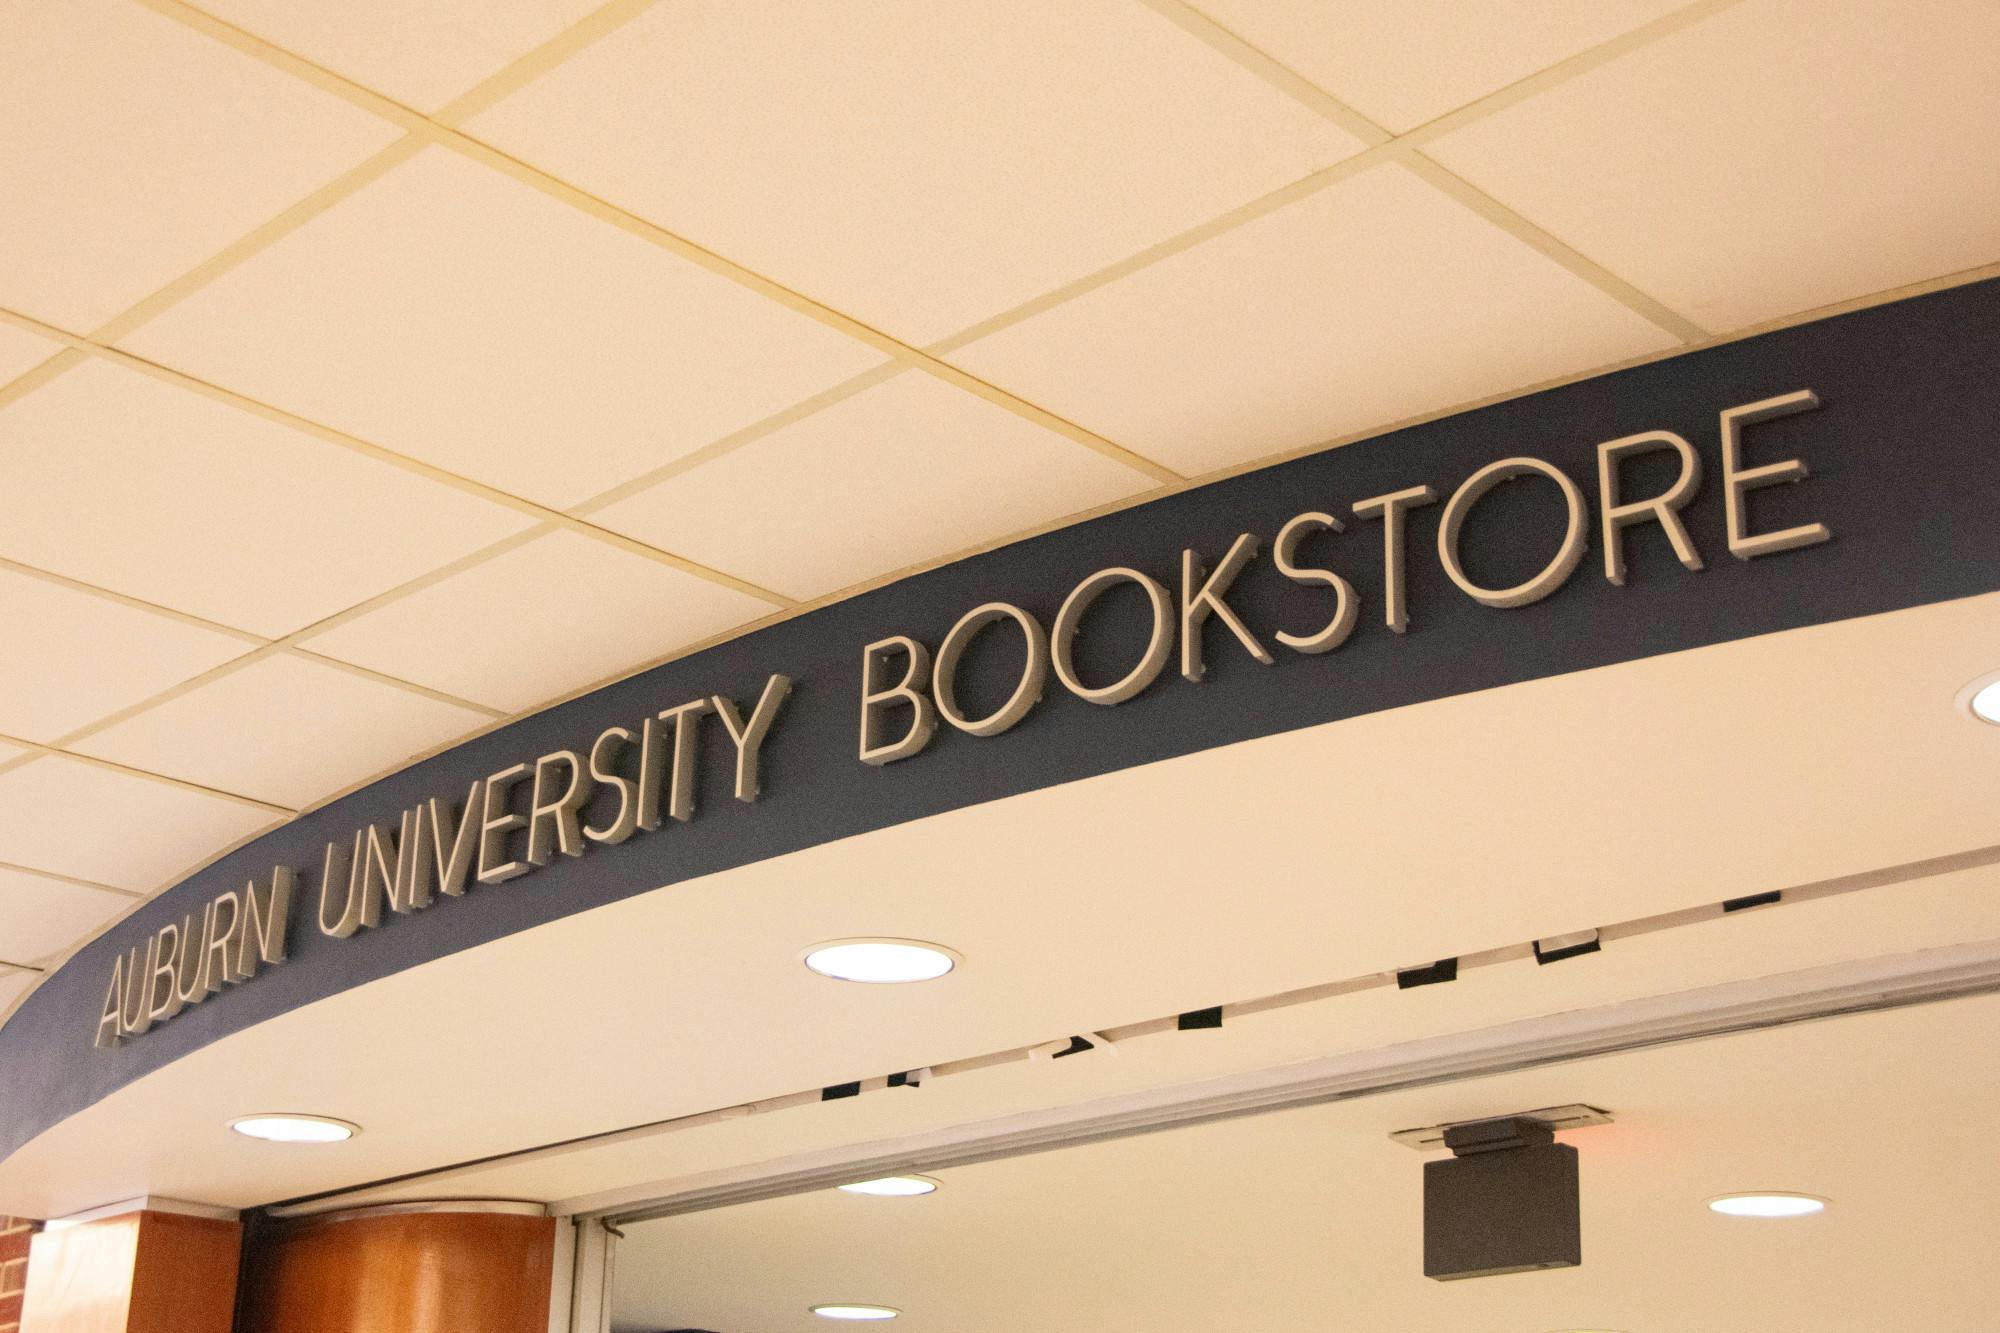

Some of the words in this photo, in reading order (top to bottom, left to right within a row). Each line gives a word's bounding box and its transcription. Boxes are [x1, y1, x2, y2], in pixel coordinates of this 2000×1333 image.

[94, 865, 291, 1048] AUBURN
[319, 673, 793, 939] UNIVERSITY
[858, 389, 1831, 766] BOOKSTORE
